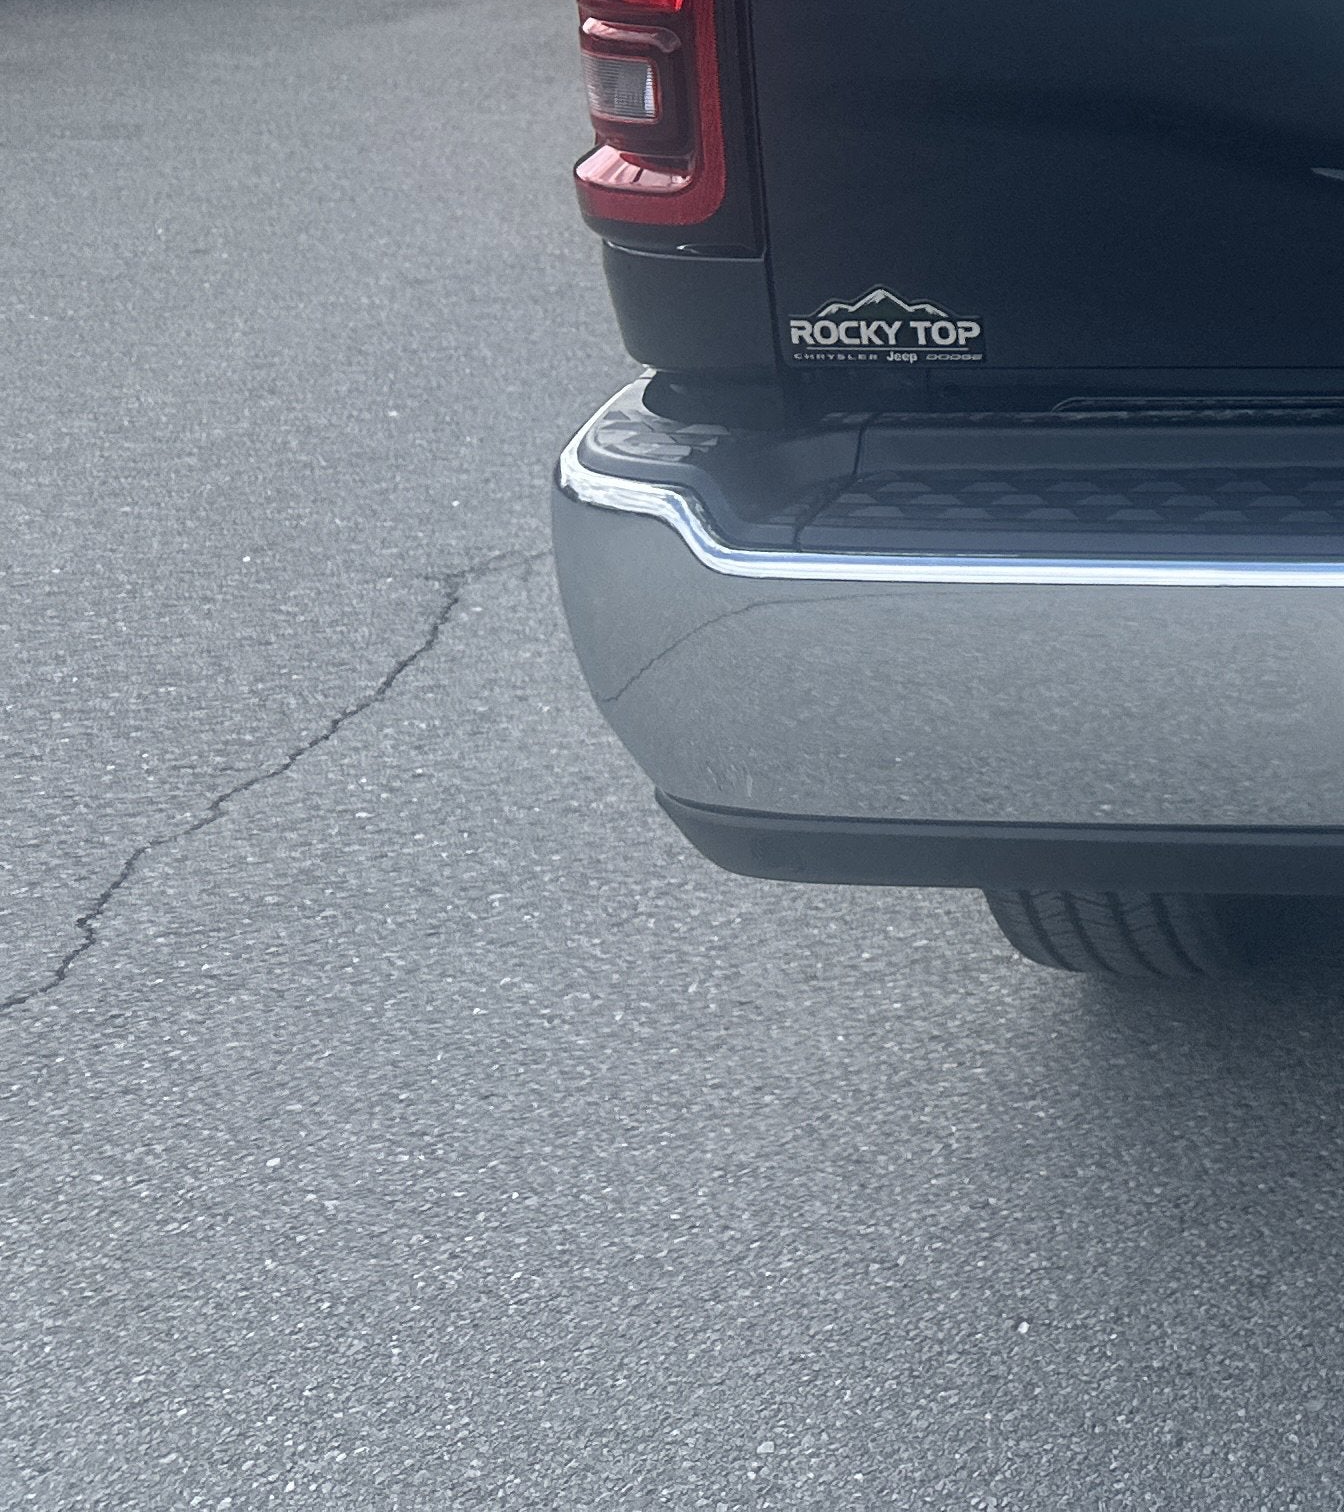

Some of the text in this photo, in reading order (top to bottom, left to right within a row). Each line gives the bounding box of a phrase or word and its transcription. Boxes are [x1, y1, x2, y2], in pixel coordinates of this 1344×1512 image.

[789, 319, 981, 345] ROCKY TOP
[886, 350, 918, 364] Jeep
